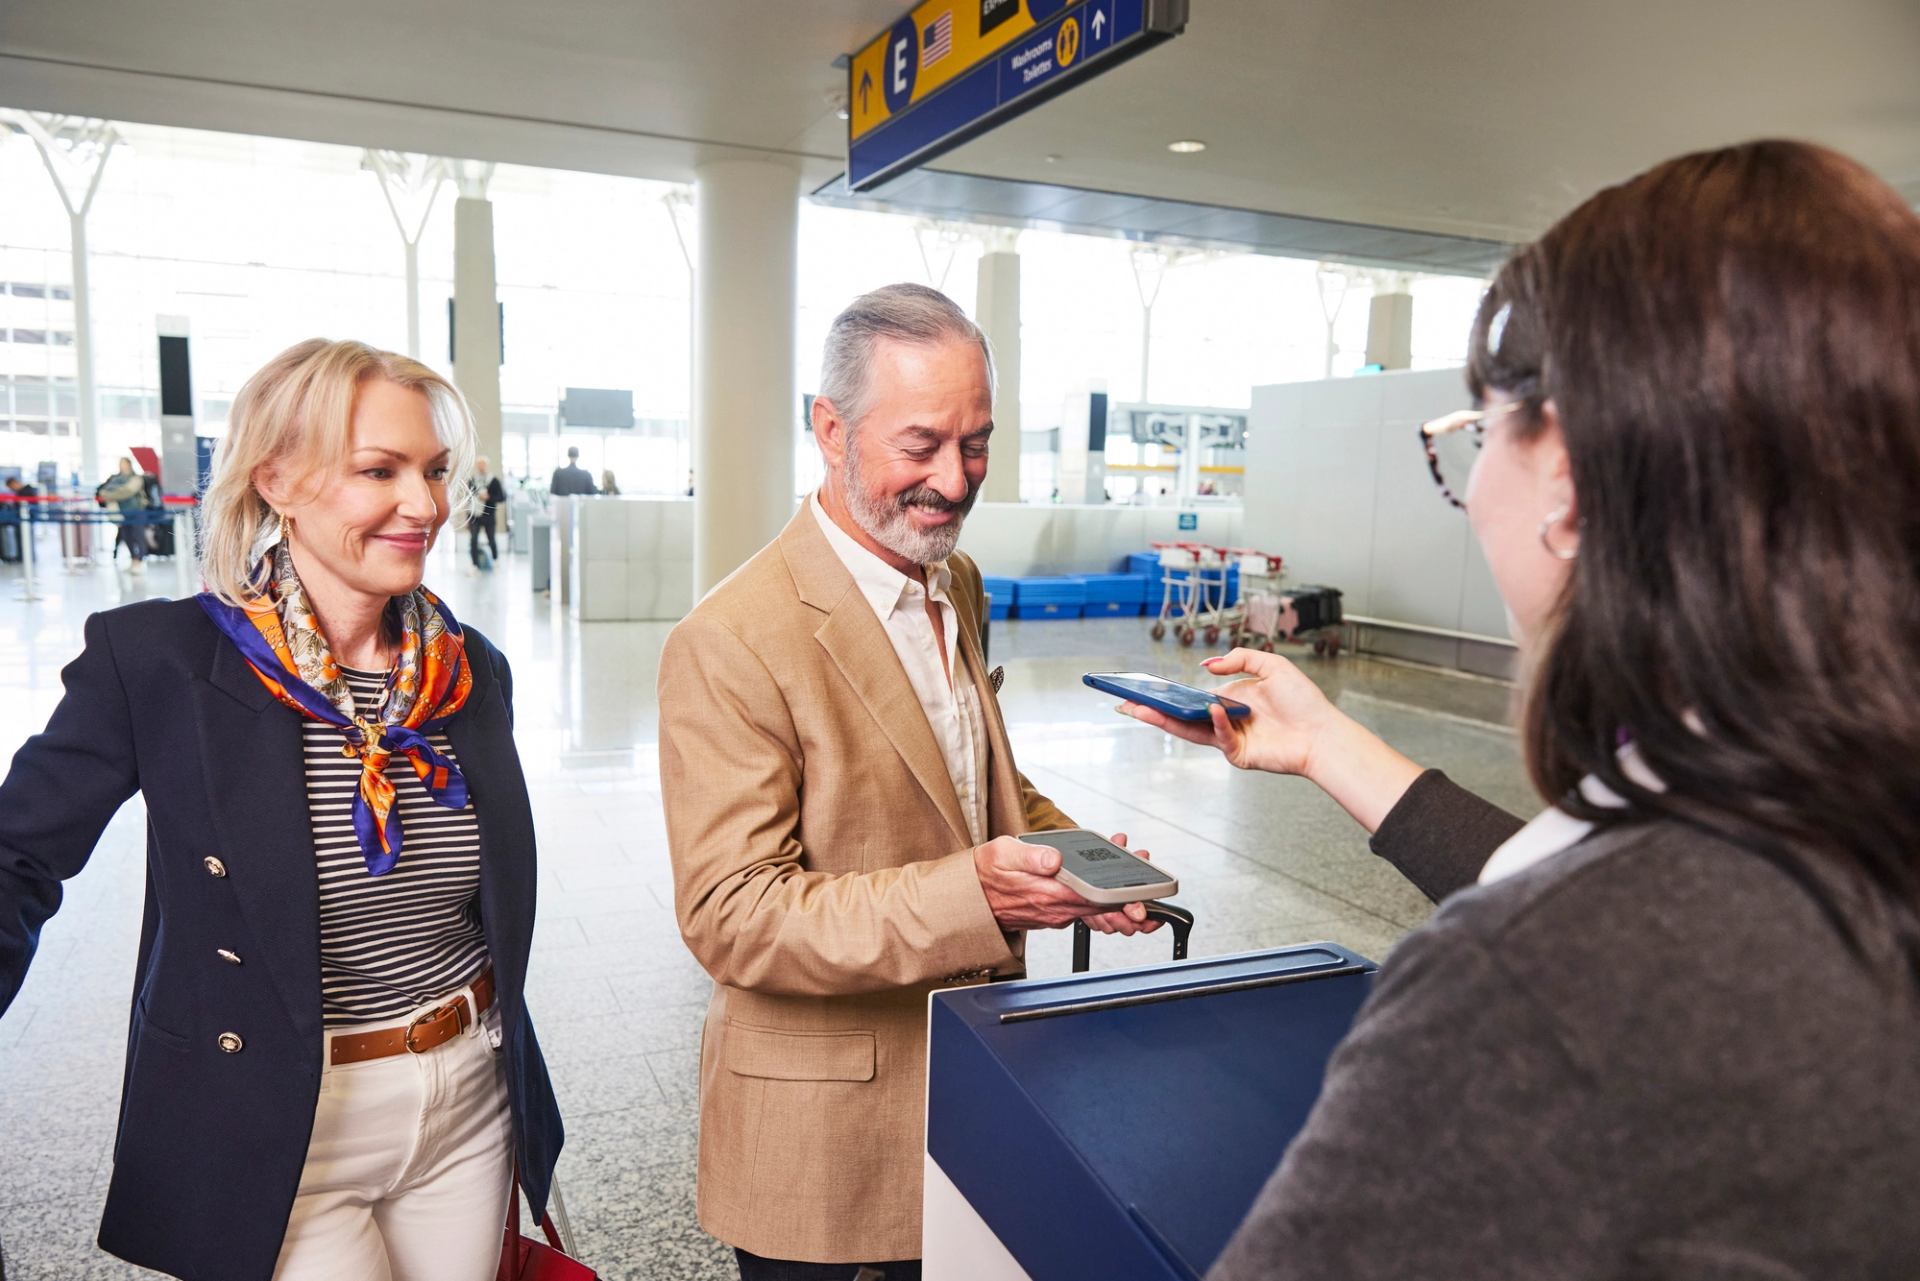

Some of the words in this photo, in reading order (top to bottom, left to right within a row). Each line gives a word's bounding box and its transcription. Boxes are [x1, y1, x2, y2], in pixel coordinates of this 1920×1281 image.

[894, 38, 907, 94] E
[1011, 38, 1052, 70] Washrooms
[1023, 59, 1052, 84] Toilettes
